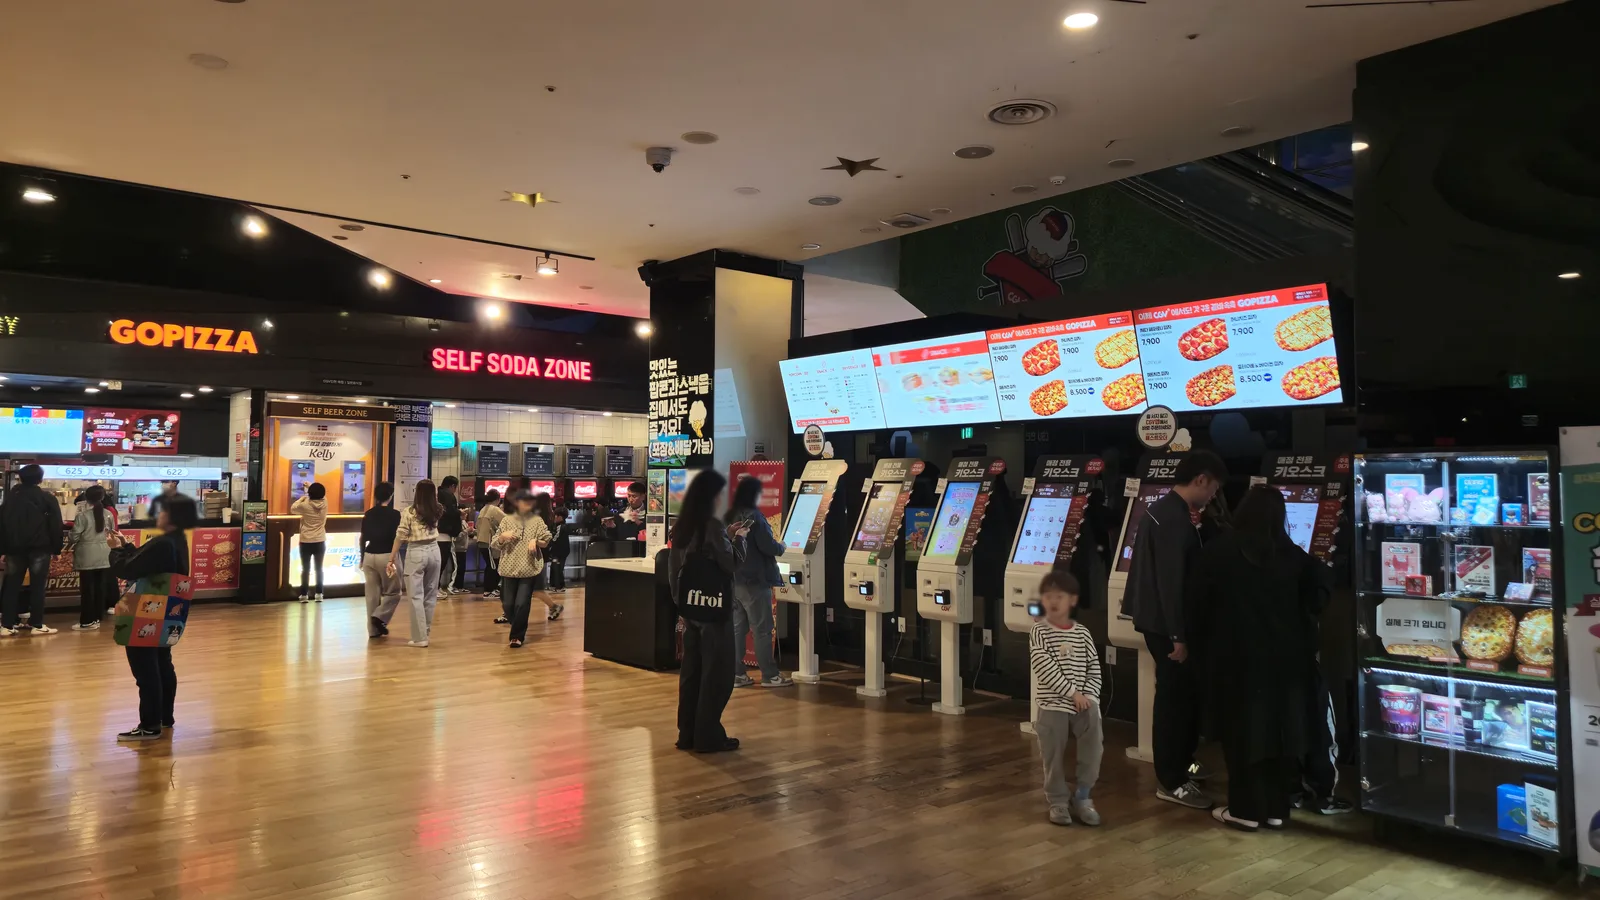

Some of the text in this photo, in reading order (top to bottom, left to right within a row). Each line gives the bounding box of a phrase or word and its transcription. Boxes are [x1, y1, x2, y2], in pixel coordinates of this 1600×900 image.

[1237, 294, 1279, 307] GOPIZZA
[1065, 319, 1097, 330] GOPIZZA
[109, 319, 259, 354] GOPIZZA
[431, 347, 591, 381] SELF SODA ZONE
[649, 357, 678, 380] 맛있는
[303, 407, 368, 417] SELF BEER ZONE
[648, 397, 688, 420] 집에서도
[309, 449, 335, 461] Kelly
[1276, 455, 1313, 464] 매점 전용
[1045, 459, 1058, 467] 매점
[1150, 458, 1165, 466] 매점
[65, 467, 83, 475] 625
[100, 467, 117, 475] 619
[166, 468, 183, 476] 622
[880, 469, 907, 478] 키오스크
[954, 468, 985, 478] 키오스크
[1042, 467, 1080, 478] 키오스크
[1146, 467, 1177, 478] 키오스
[1273, 465, 1326, 478] 키오스크
[45, 578, 81, 589] PIZZA
[686, 588, 723, 608] ffroi
[1385, 618, 1447, 630] 실제 크기 입니다
